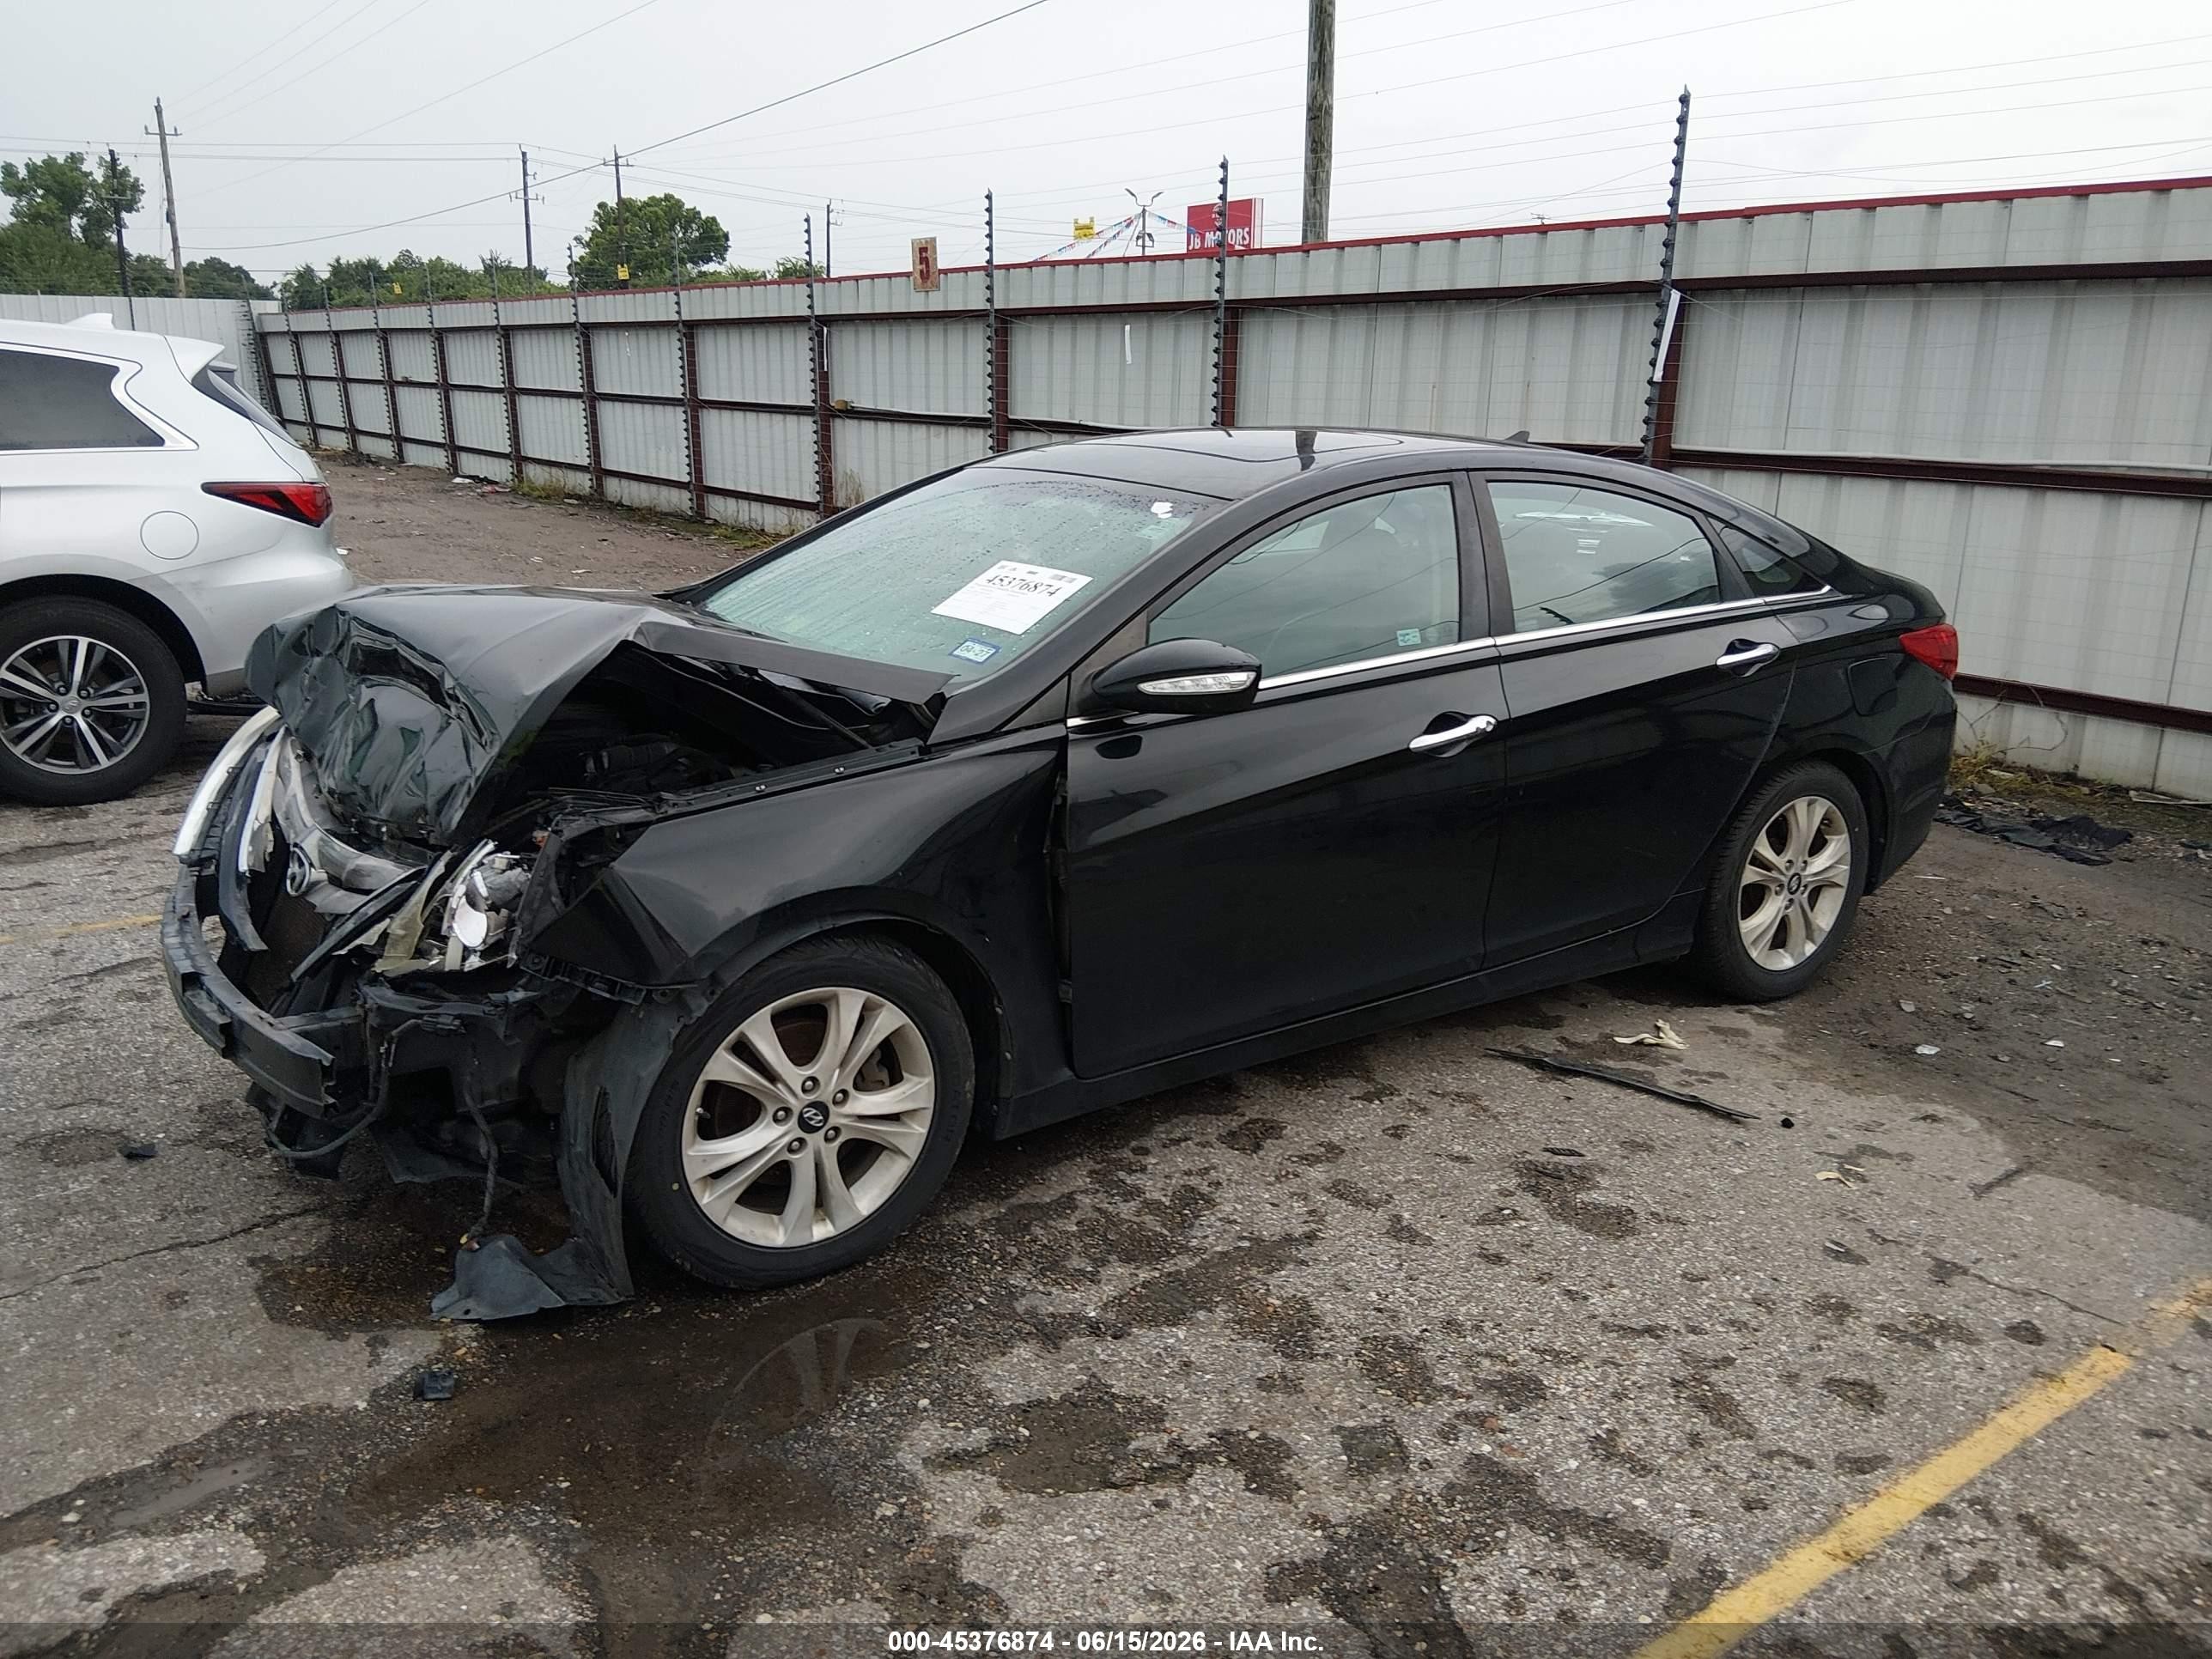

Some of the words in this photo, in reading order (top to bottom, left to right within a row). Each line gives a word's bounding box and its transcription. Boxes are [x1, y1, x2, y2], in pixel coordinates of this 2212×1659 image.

[1188, 233, 1201, 250] JB
[1205, 228, 1249, 248] MOORS
[919, 246, 930, 283] 5
[986, 574, 1062, 597] 45376874
